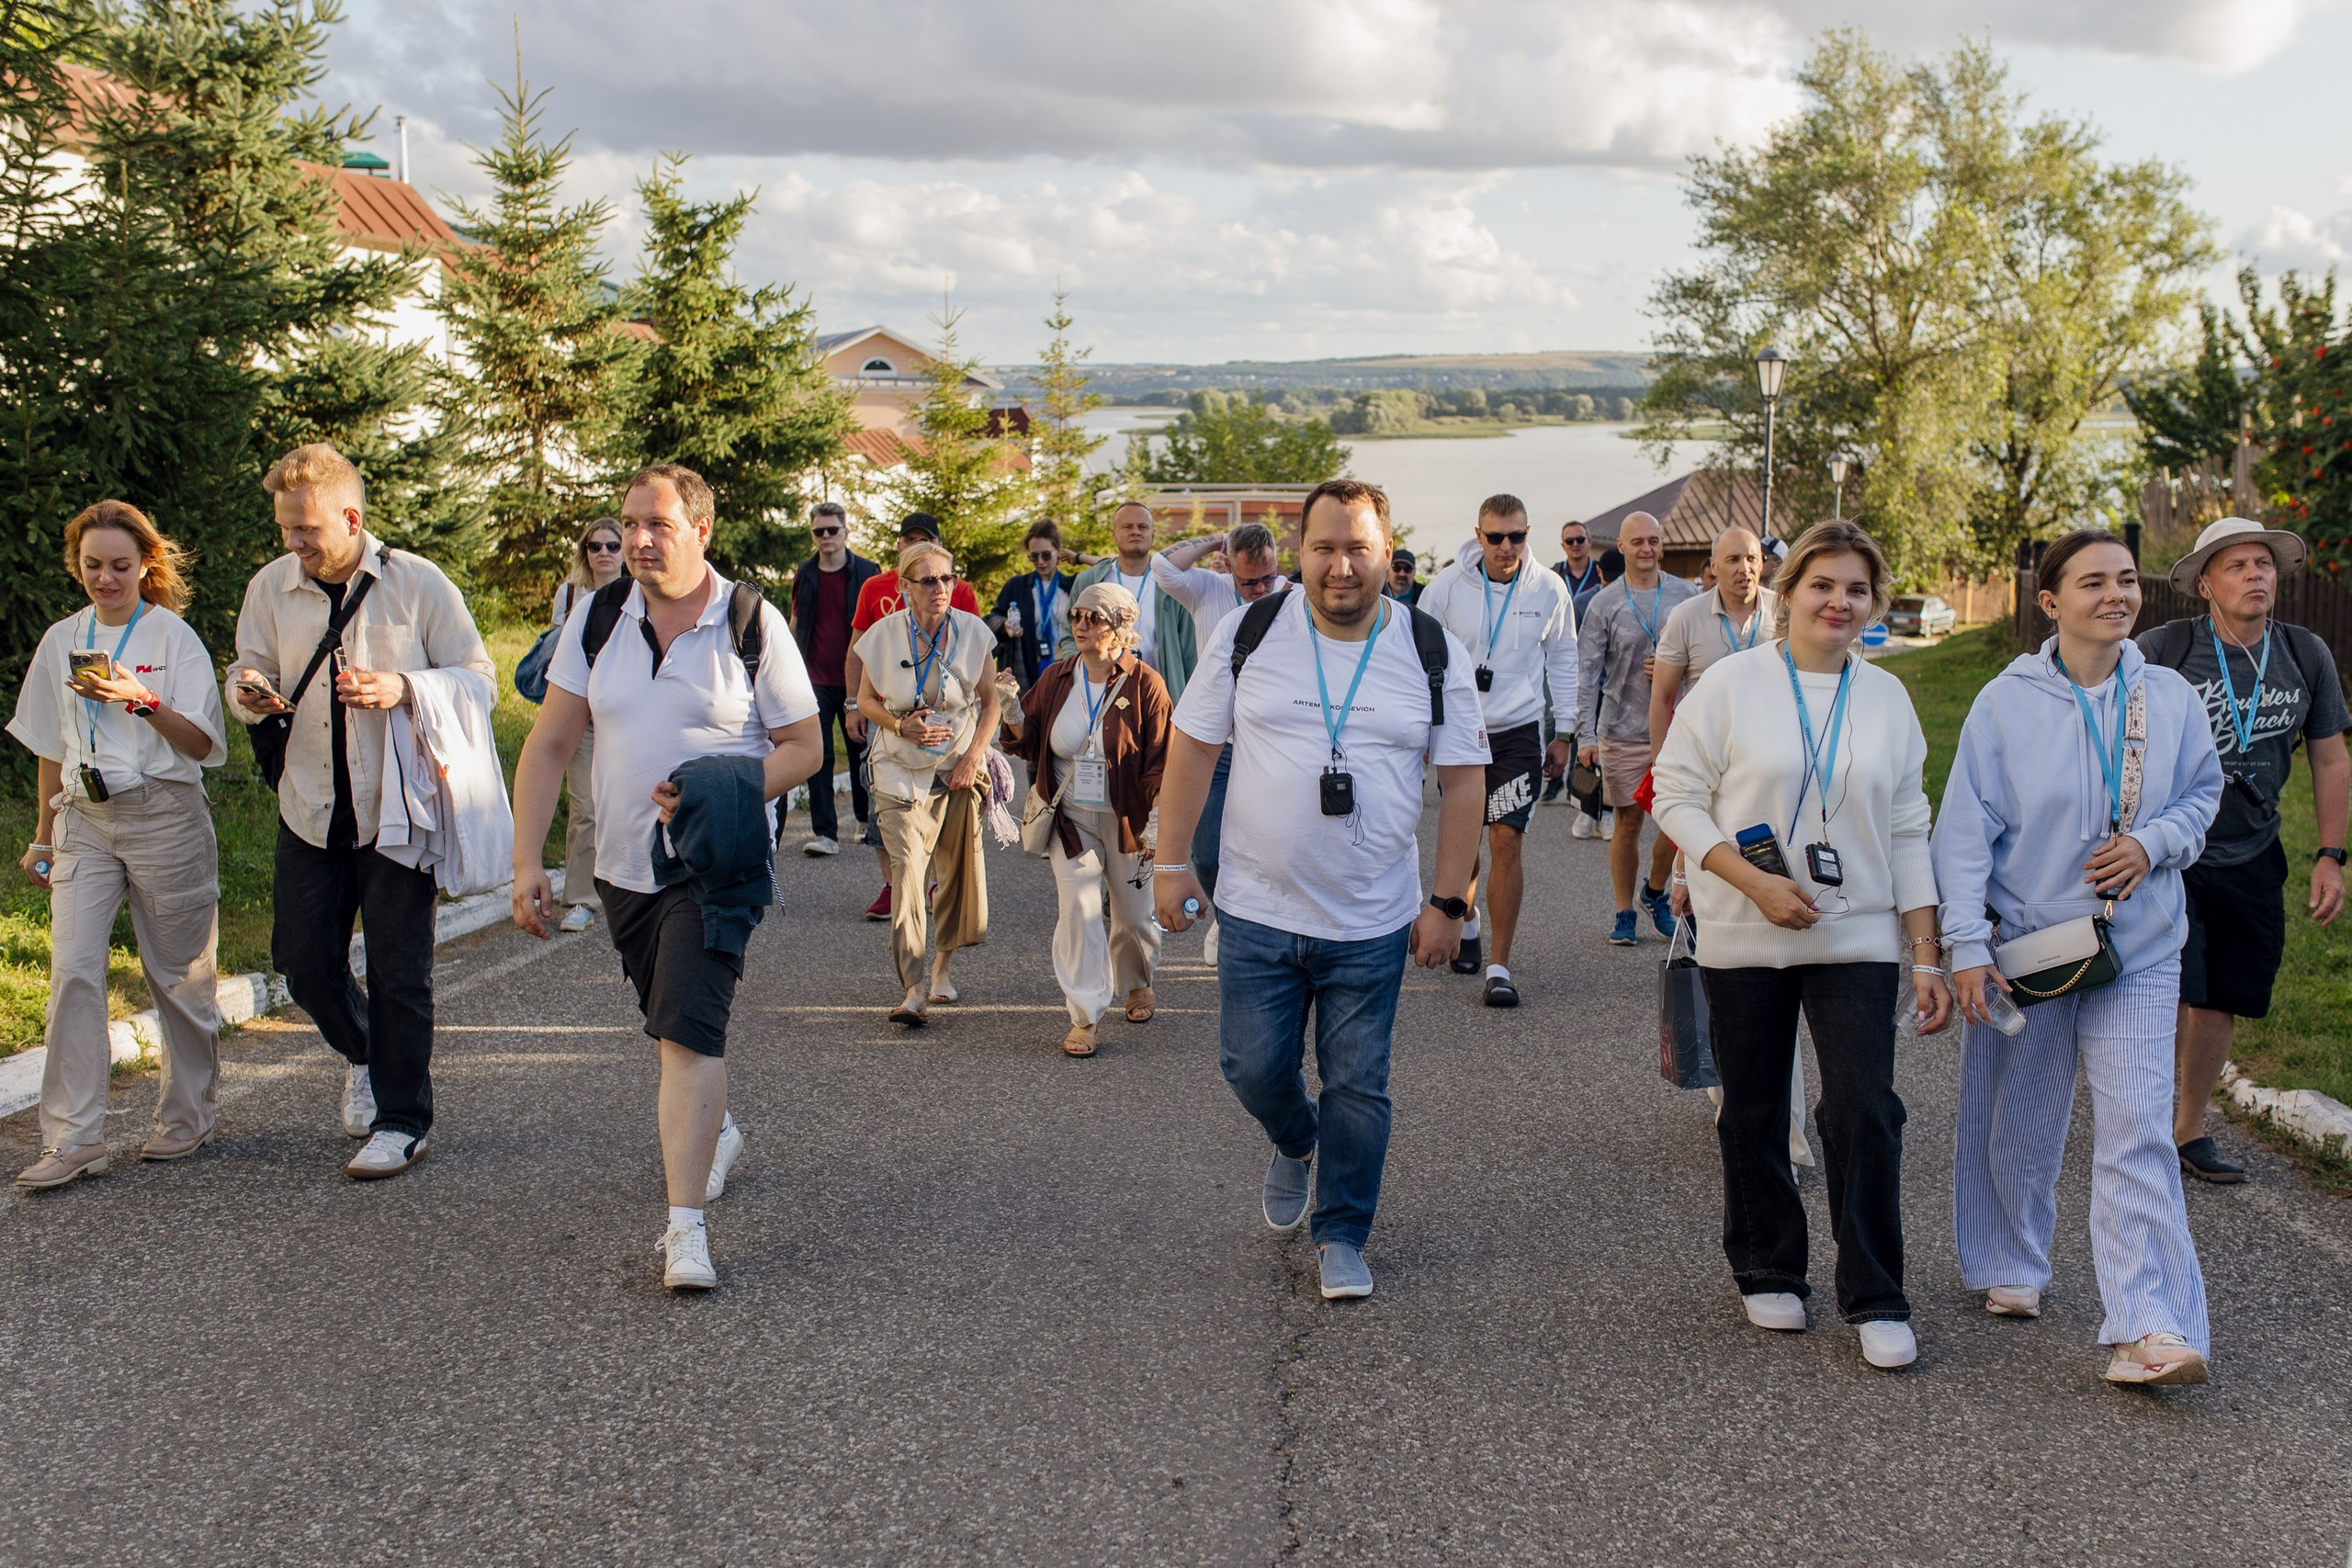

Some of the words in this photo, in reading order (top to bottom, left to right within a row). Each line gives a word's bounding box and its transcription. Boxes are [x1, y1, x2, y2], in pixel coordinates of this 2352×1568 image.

[1785, 650, 1804, 705] WWW.TOUR-AUDIO.RU
[1293, 699, 1321, 708] ARTEM
[1488, 772, 1532, 822] NIKE
